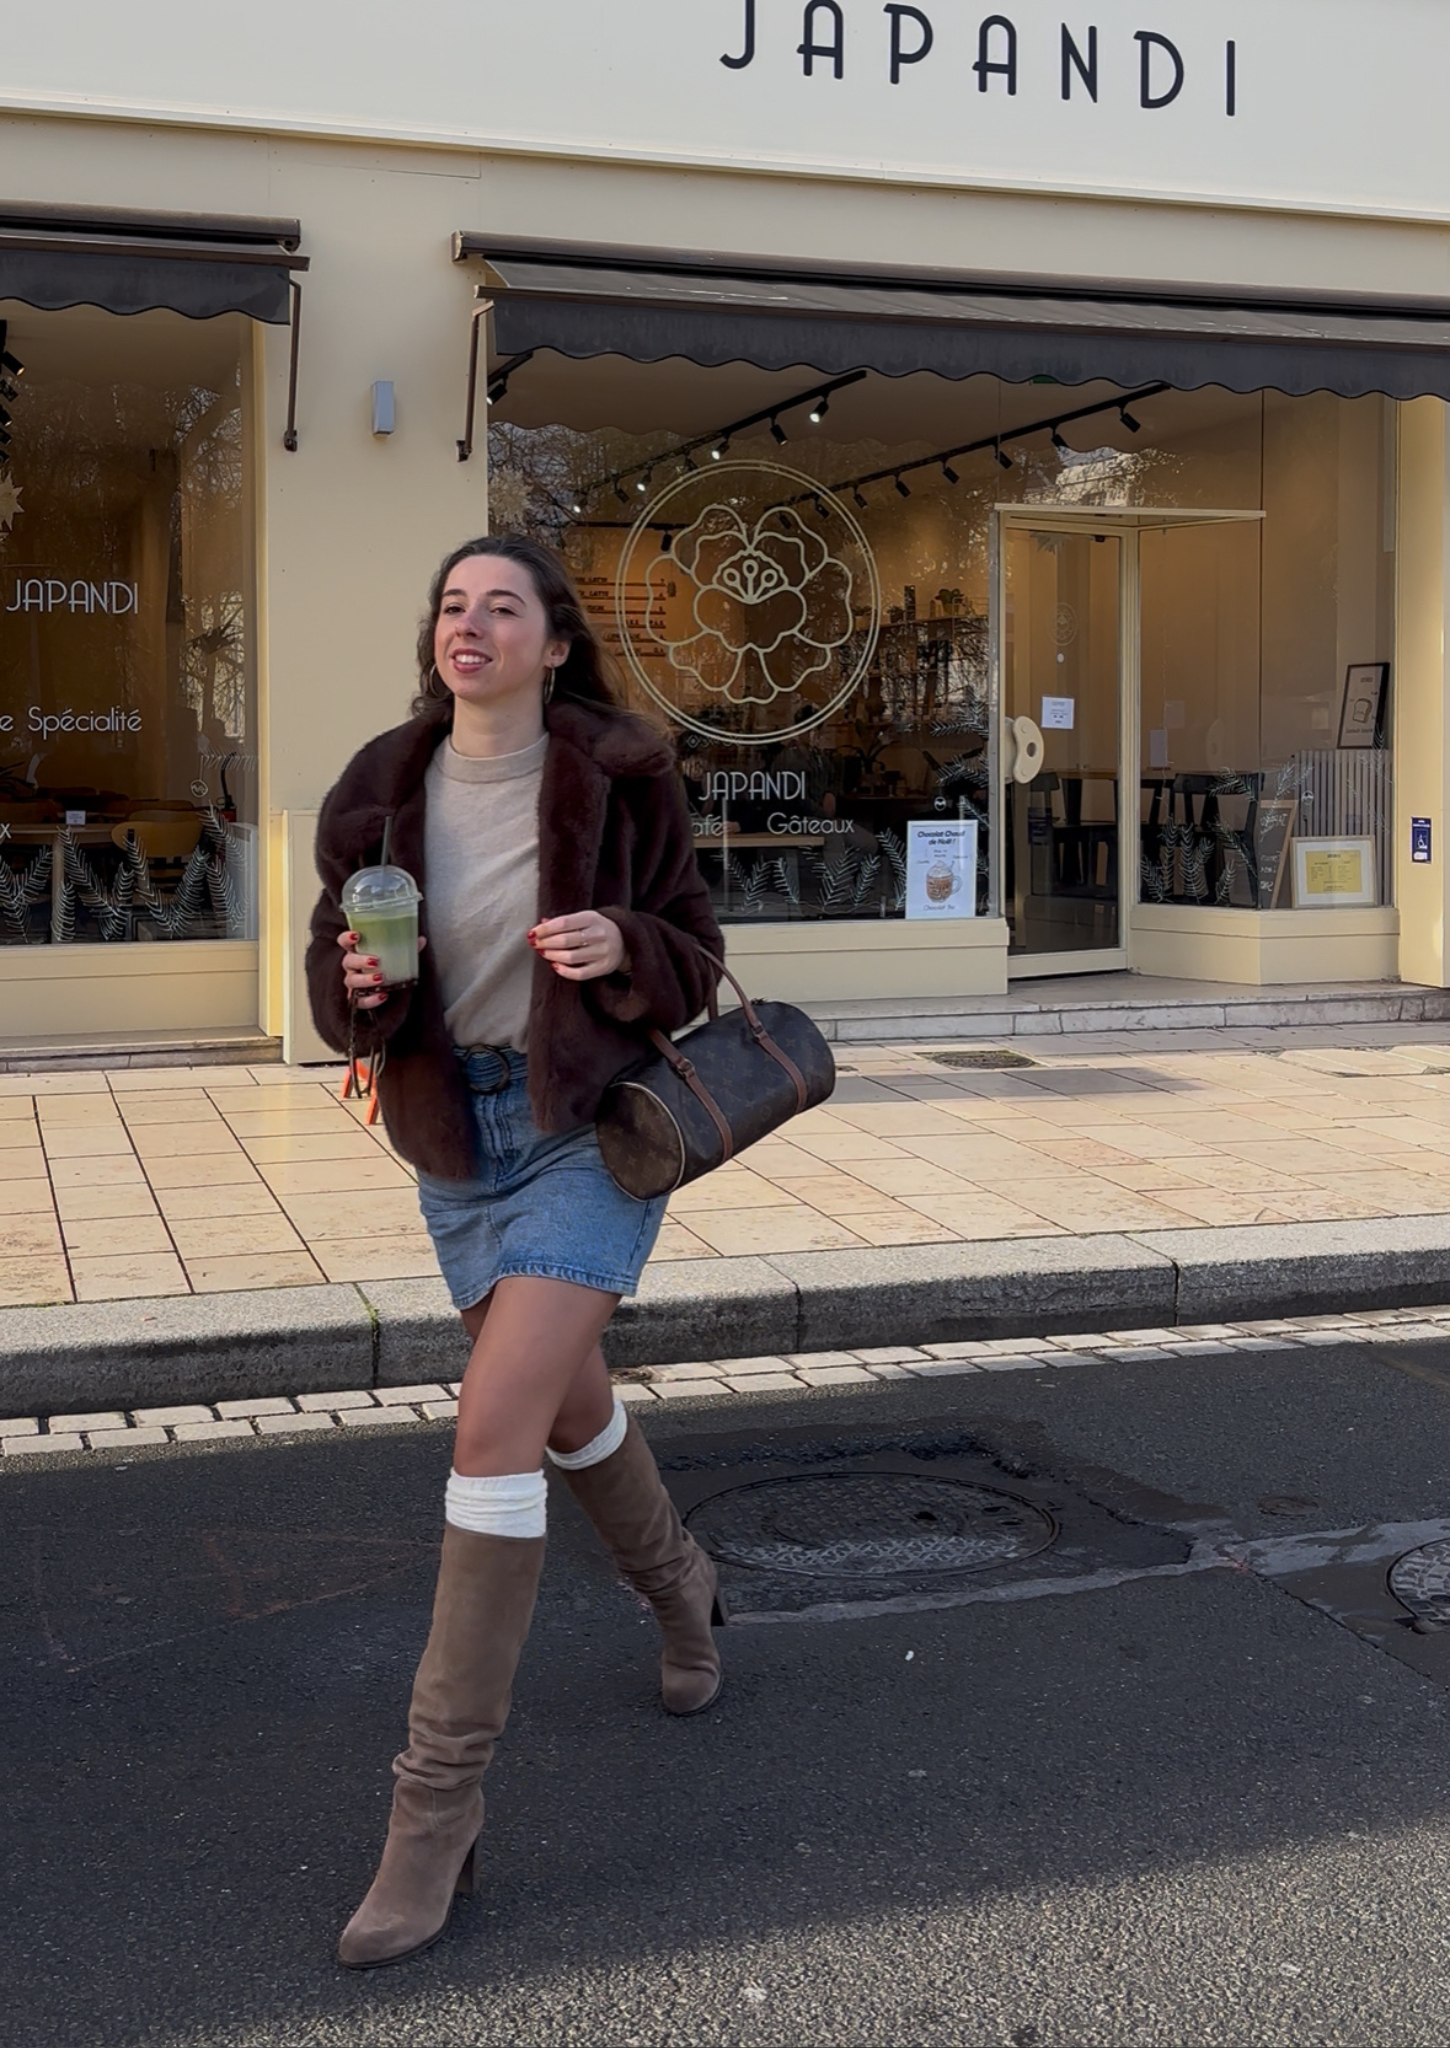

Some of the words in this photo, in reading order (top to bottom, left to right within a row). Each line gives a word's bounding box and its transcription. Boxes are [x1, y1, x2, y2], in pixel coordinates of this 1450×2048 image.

[719, 0, 1236, 117] JAPANDI
[6, 579, 139, 615] JAPANDI
[27, 706, 142, 740] Spécialité
[698, 771, 806, 801] JAPANDI
[692, 815, 724, 836] afé
[766, 812, 855, 835] Gâteaux
[917, 830, 944, 838] Chocolat
